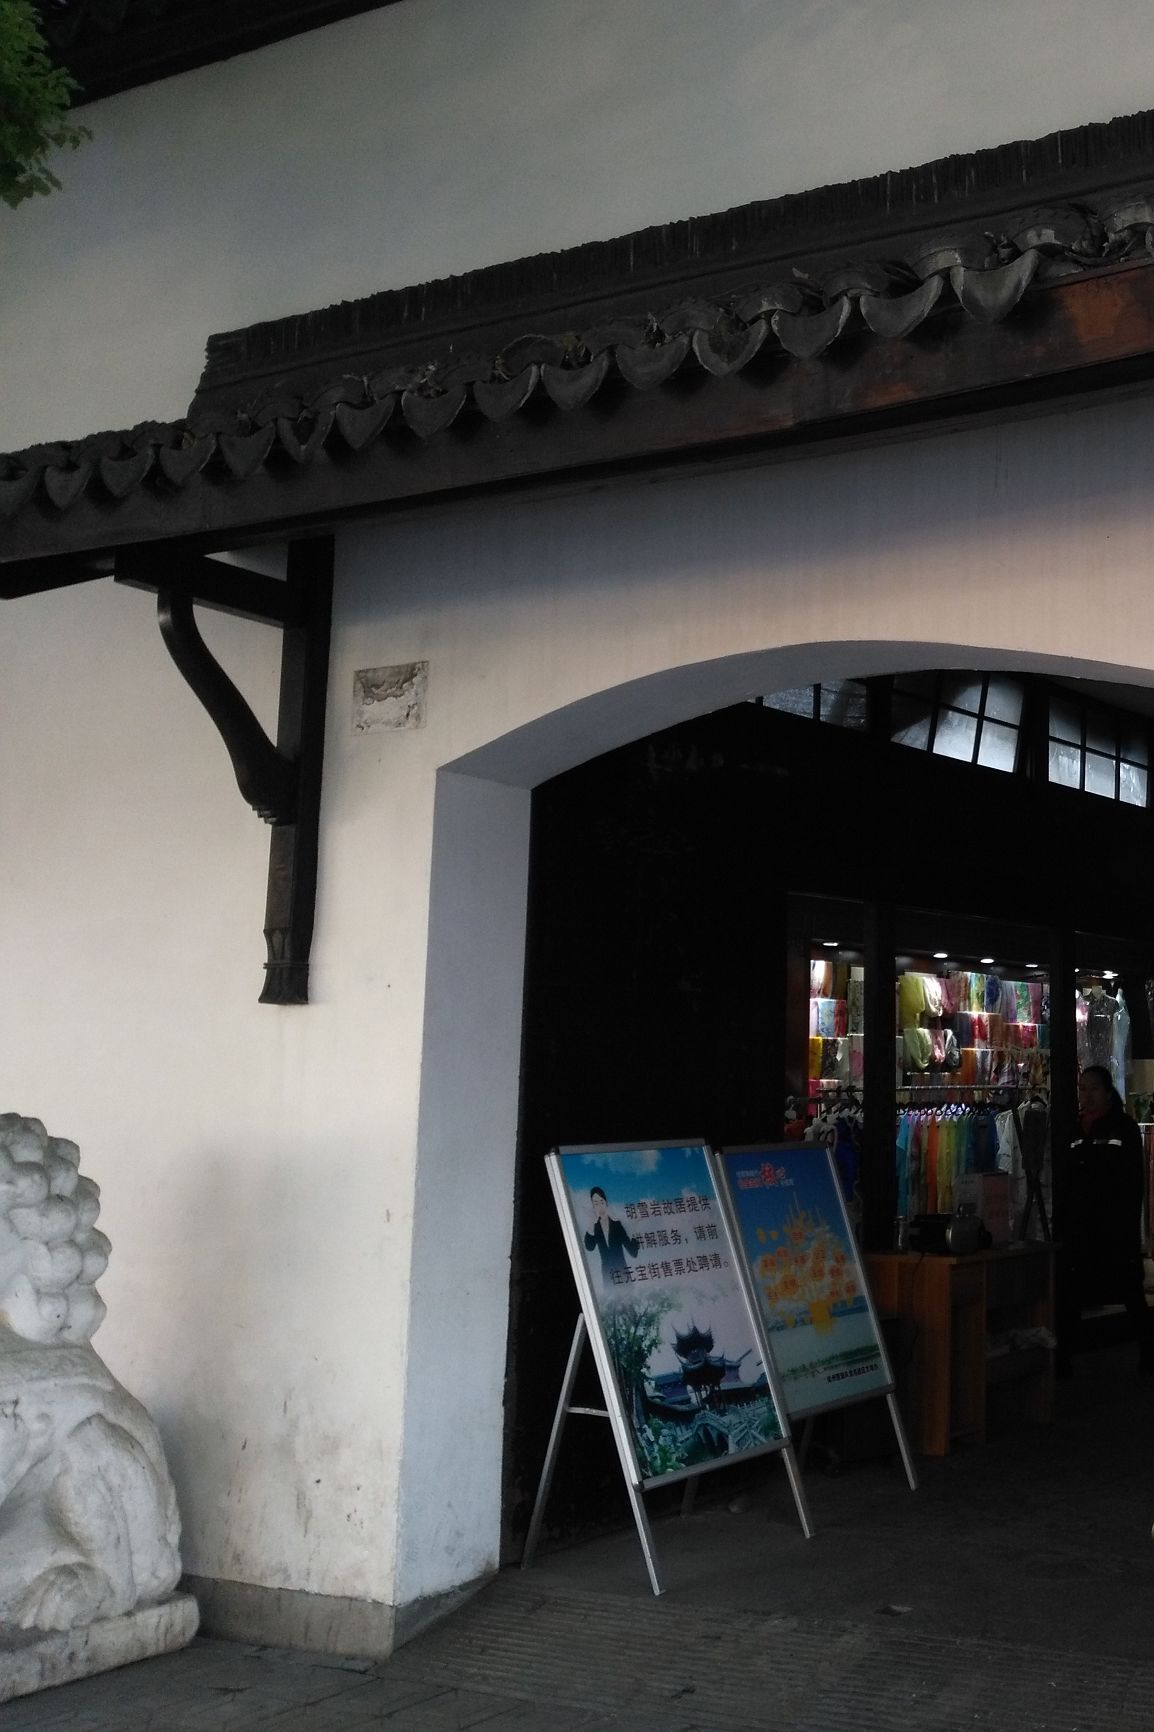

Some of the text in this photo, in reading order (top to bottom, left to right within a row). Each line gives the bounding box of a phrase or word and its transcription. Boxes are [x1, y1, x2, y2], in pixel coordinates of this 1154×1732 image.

[624, 1195, 712, 1220] 胡雪岩故居提供
